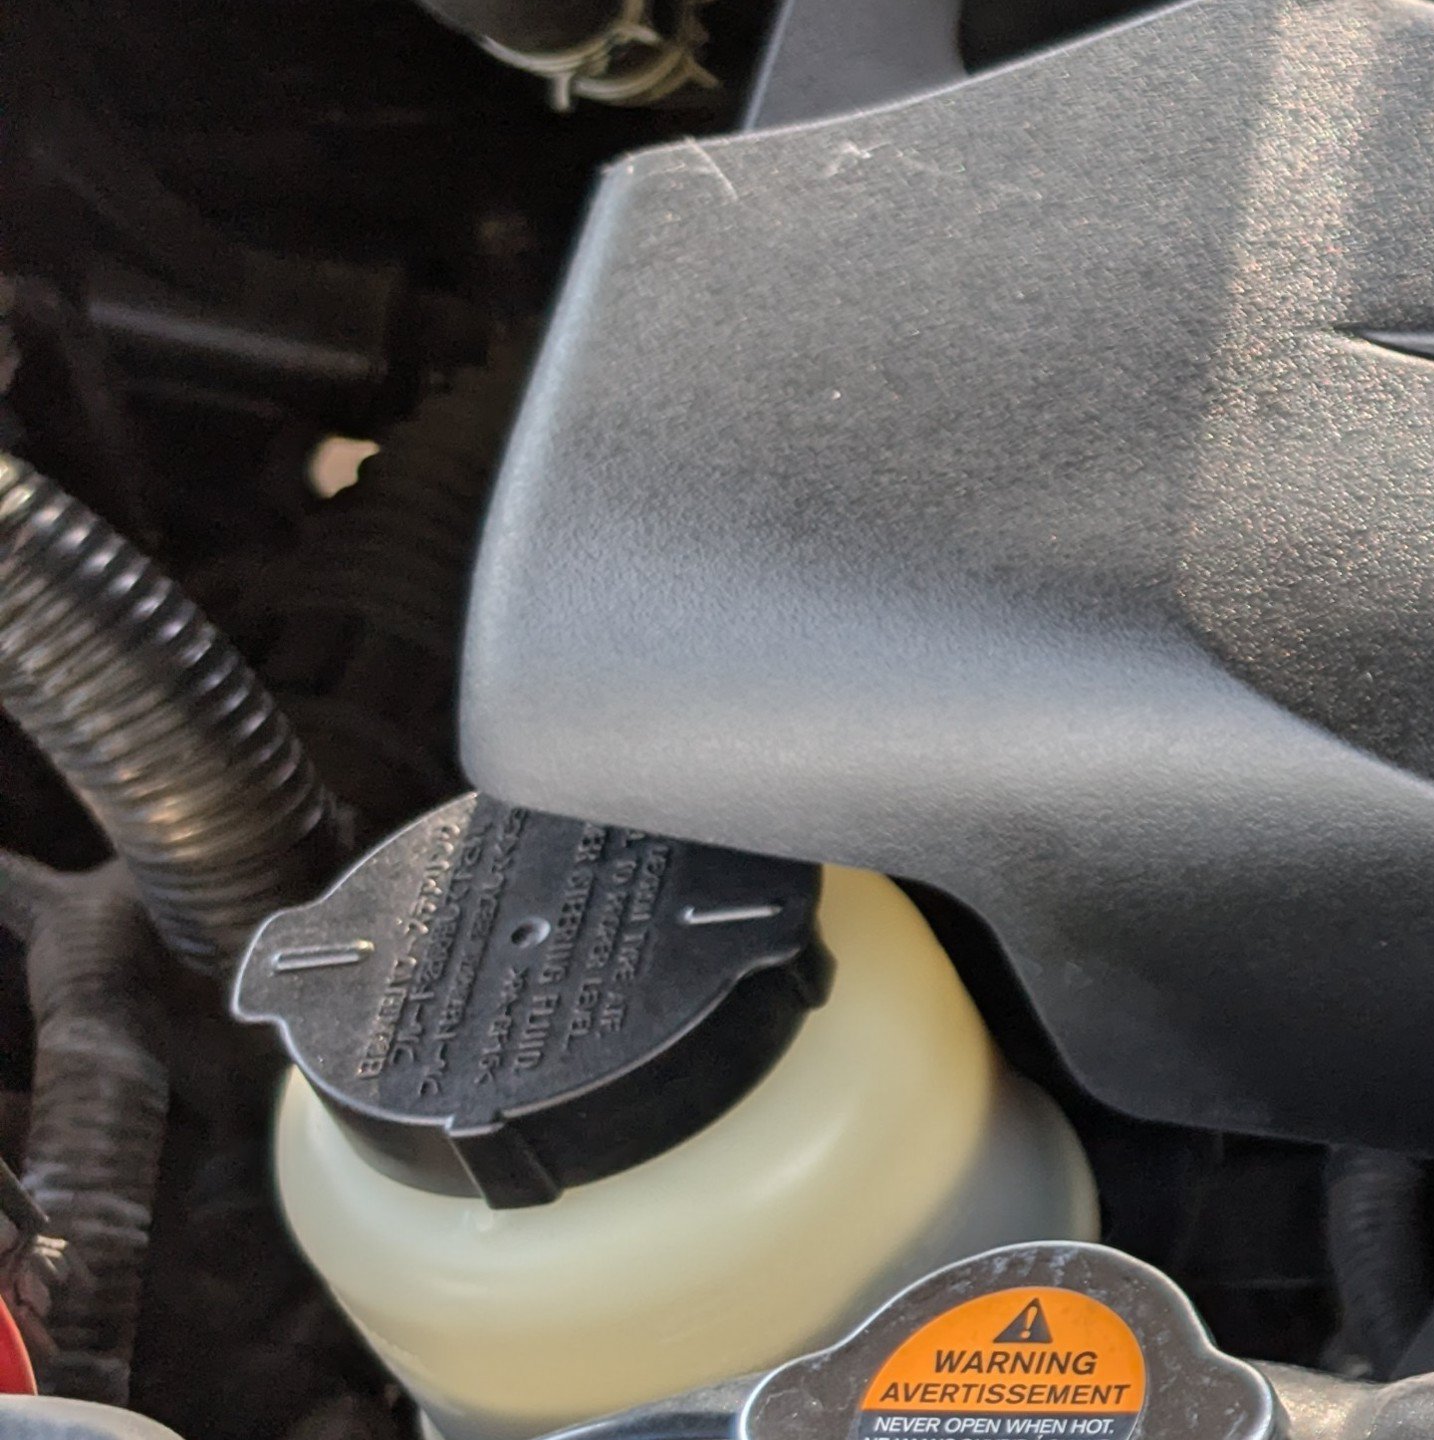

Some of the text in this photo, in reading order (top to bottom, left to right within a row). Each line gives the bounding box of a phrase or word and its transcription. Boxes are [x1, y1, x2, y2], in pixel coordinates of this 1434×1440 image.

[934, 1350, 1098, 1375] WARNING
[880, 1382, 1131, 1405] AVERTISSEMENT
[874, 1417, 1114, 1434] NEVER OPEN WHEN HOT.
